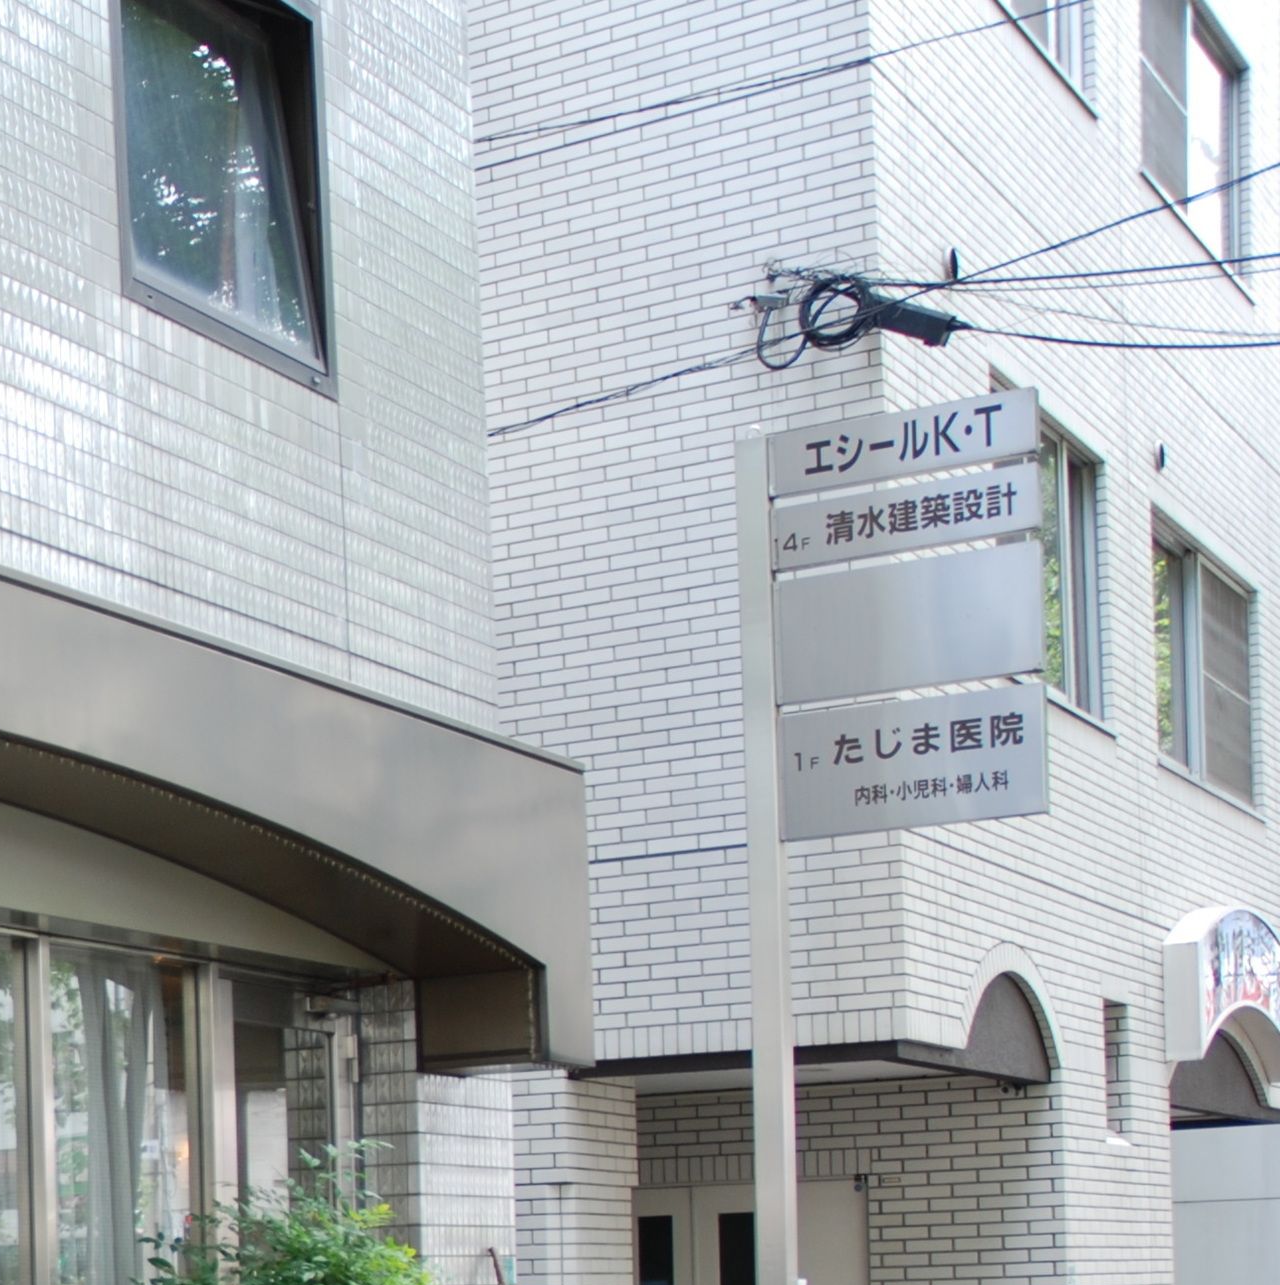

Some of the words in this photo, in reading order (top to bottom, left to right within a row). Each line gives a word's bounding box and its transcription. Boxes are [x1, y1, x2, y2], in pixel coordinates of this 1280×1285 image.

[826, 482, 1017, 545] 清水建築設計
[833, 712, 1023, 765] たじま医院
